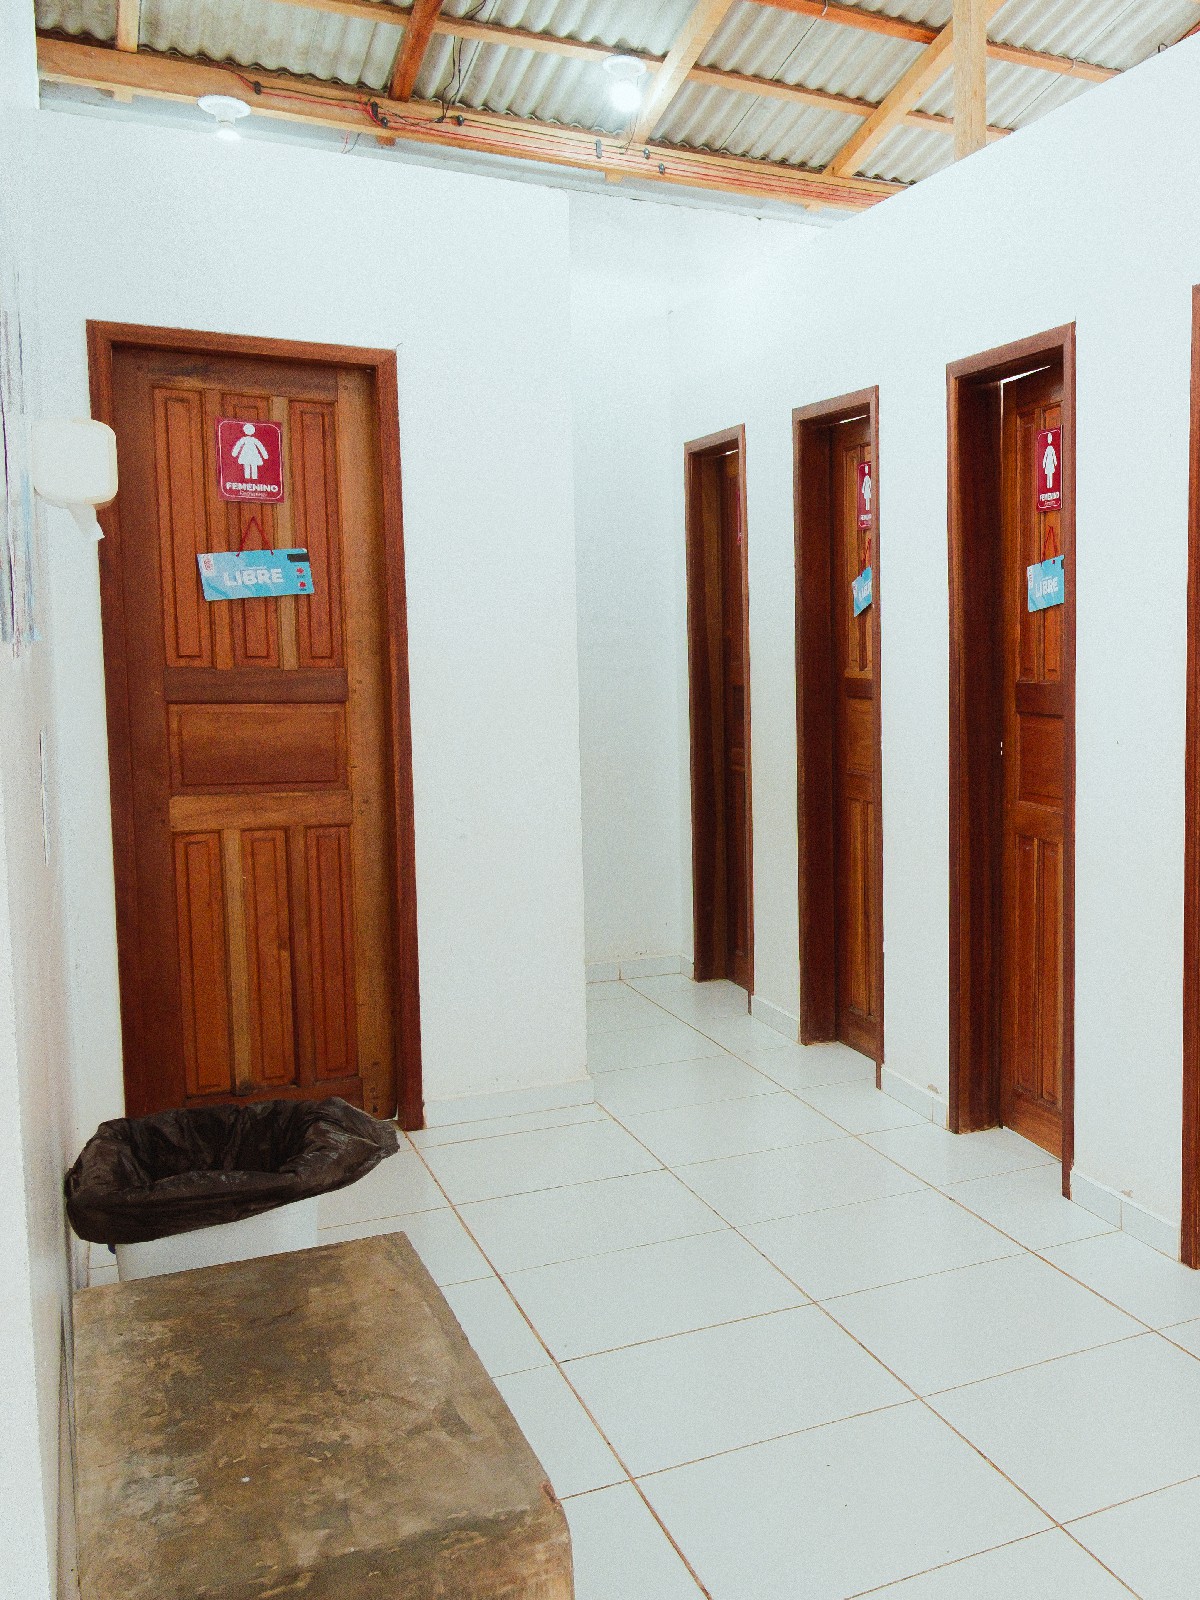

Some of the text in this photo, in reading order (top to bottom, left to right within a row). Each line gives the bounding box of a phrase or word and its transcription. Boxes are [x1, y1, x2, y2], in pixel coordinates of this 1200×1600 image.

[226, 481, 278, 492] FEMENINO
[223, 568, 284, 586] LIBRE
[1036, 577, 1058, 597] LIBRE
